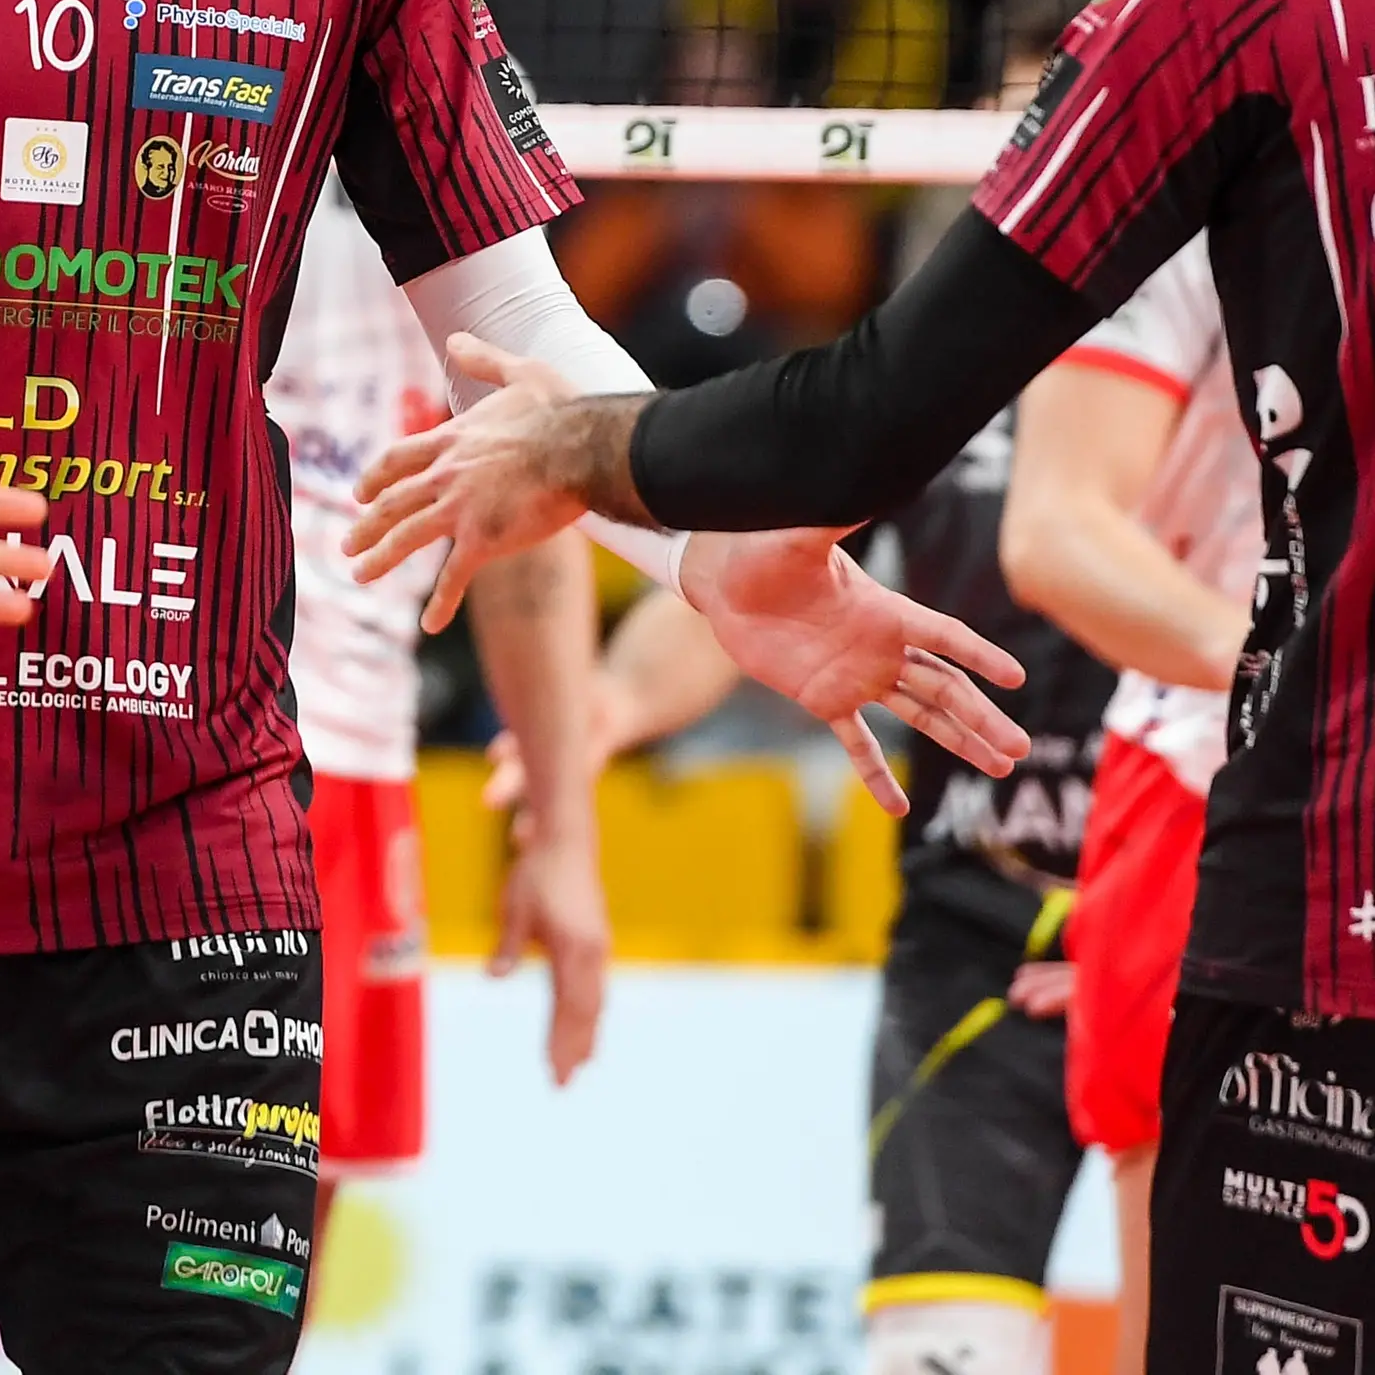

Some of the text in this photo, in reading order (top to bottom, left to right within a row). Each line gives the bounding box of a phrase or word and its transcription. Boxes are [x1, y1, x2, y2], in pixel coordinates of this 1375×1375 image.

[4, 178, 81, 189] HOTEL PALACE
[61, 309, 102, 333] PER
[107, 315, 122, 334] IL
[121, 315, 239, 345] COMFORT
[149, 607, 191, 622] GROUP
[17, 651, 194, 699] ECOLOGY
[90, 695, 102, 712] E
[105, 696, 195, 721] AMBIENTALI
[110, 1017, 324, 1061] CLINICA PHO
[1223, 1167, 1307, 1207] MULTI
[146, 1204, 257, 1244] Polimeni
